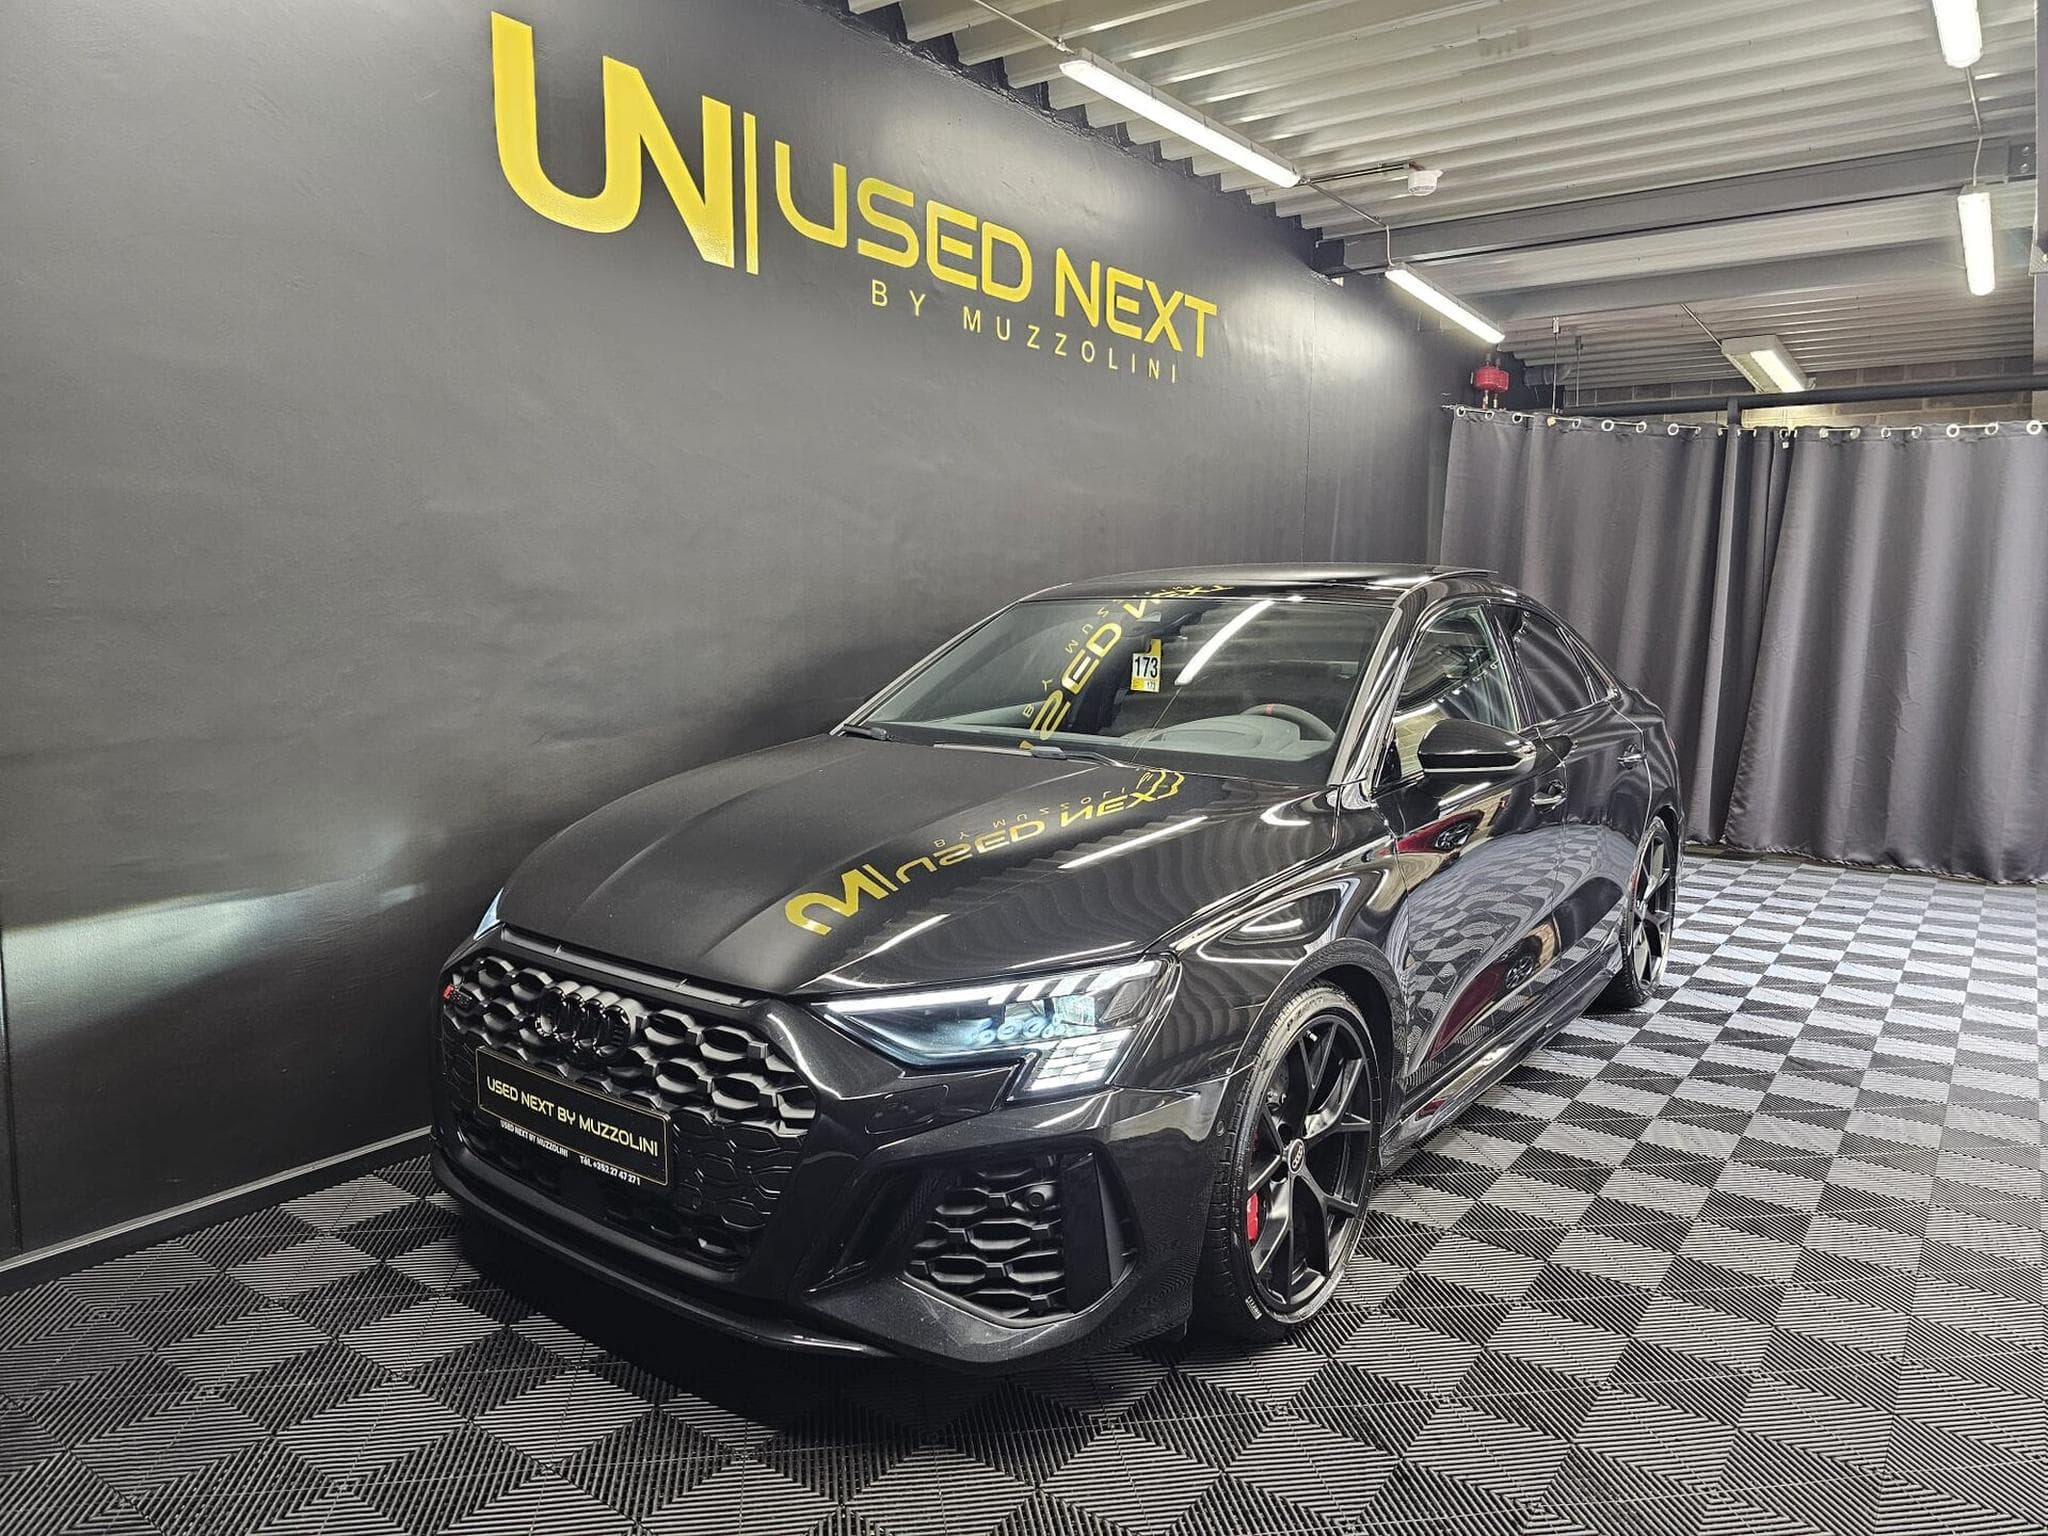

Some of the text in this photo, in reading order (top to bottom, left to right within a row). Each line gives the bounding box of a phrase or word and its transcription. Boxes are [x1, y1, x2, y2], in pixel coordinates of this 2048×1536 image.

[775, 140, 1217, 358] USED NEXT
[871, 279, 1176, 384] BY MUZZOLINI
[1135, 656, 1159, 678] 173
[486, 1075, 658, 1157] USED NEXT BY MUZZOLINI
[500, 1119, 515, 1133] USED
[515, 1126, 528, 1139] NEXT
[536, 1136, 569, 1158] MUZZOLINI
